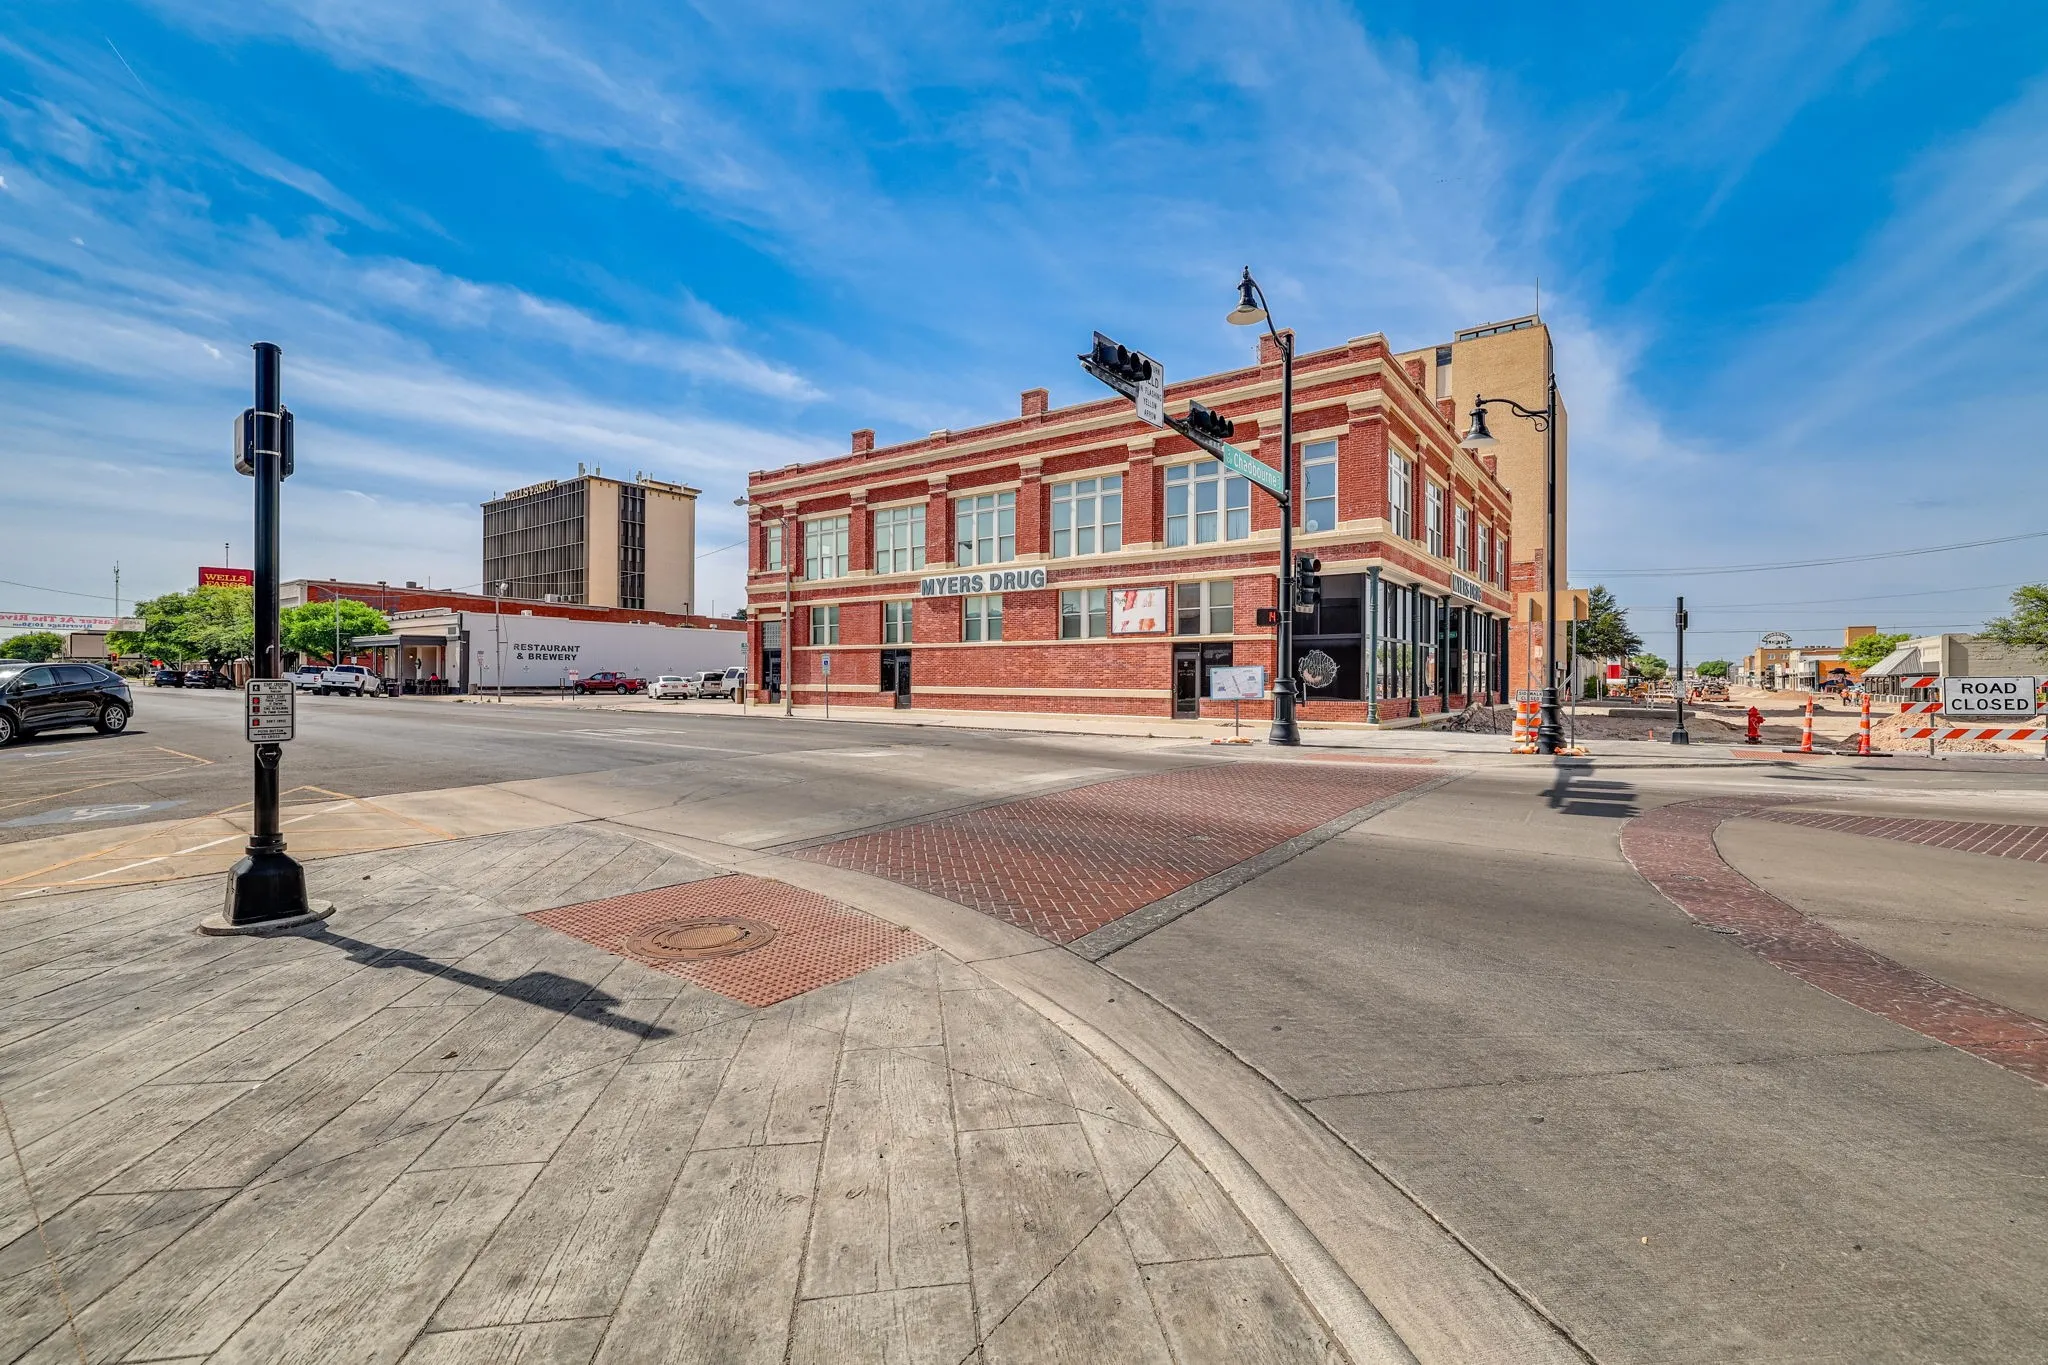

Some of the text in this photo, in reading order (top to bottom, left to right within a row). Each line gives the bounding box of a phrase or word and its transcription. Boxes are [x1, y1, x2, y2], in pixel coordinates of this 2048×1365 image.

[1143, 397, 1157, 410] YELLOW
[1233, 452, 1277, 487] Chadbourne
[504, 480, 557, 501] WELLS FARGO
[204, 573, 247, 583] WELLS
[921, 569, 1045, 596] MYERS DRUG
[513, 643, 581, 653] RESTAURANT
[516, 652, 577, 661] & BREWERY
[1961, 682, 2017, 694] ROAD
[1951, 698, 2029, 710] CLOSED
